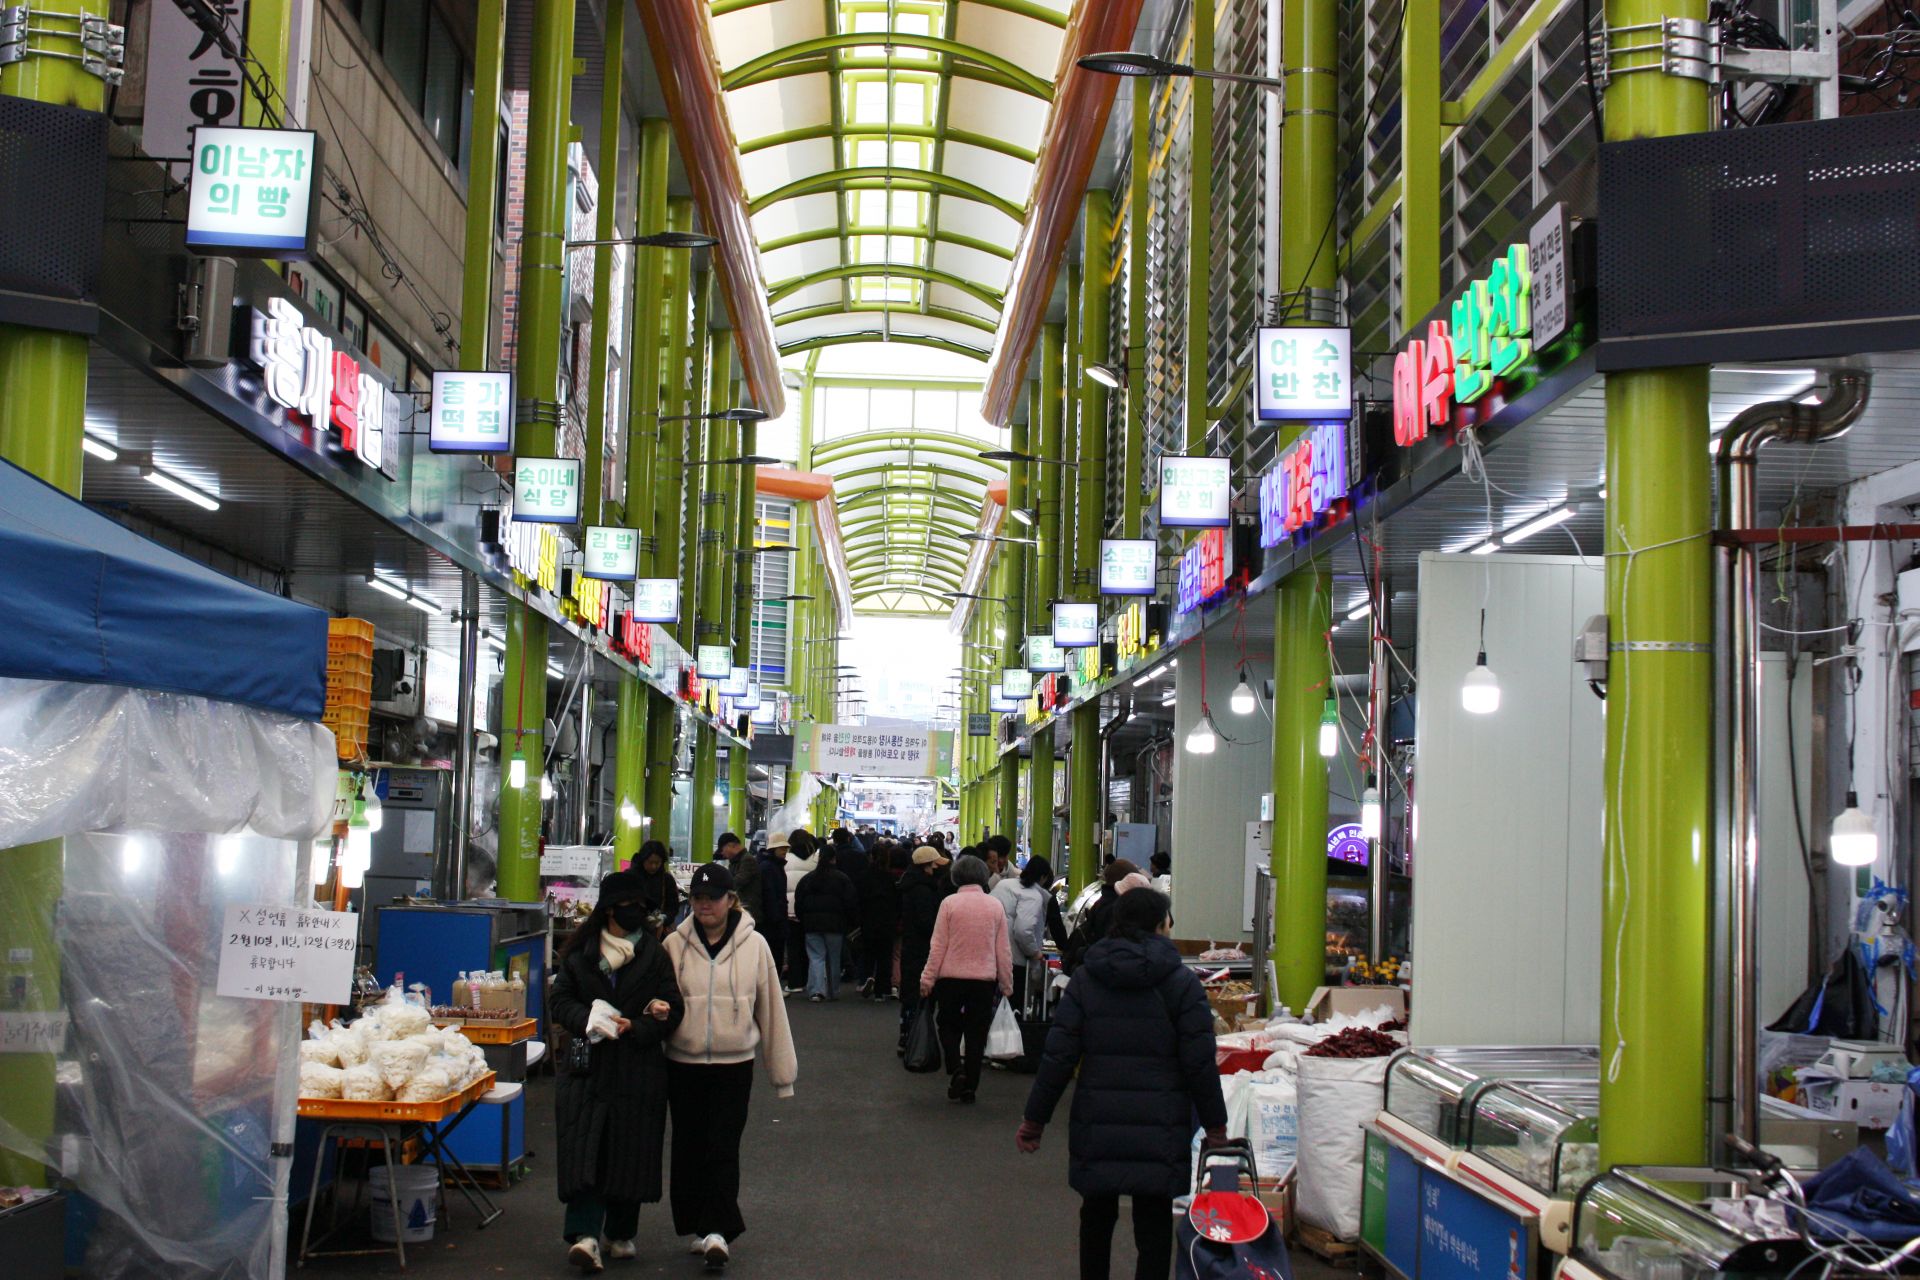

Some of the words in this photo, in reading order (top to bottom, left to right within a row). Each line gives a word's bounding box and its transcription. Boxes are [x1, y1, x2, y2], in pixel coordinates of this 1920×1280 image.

[200, 143, 306, 182] 이남자
[207, 183, 241, 216] 의
[257, 185, 291, 218] 빵
[1270, 338, 1340, 367] 여수
[442, 380, 503, 406] 종가
[1271, 371, 1341, 400] 반찬
[441, 409, 500, 434] 떡집
[518, 467, 575, 487] 숙이네
[523, 489, 568, 507] 식당
[1176, 489, 1213, 510] 상회
[592, 533, 633, 551] 김밥
[602, 552, 620, 568] 짱
[1104, 547, 1152, 564] 소문난
[249, 954, 296, 970] 휴무합니다
